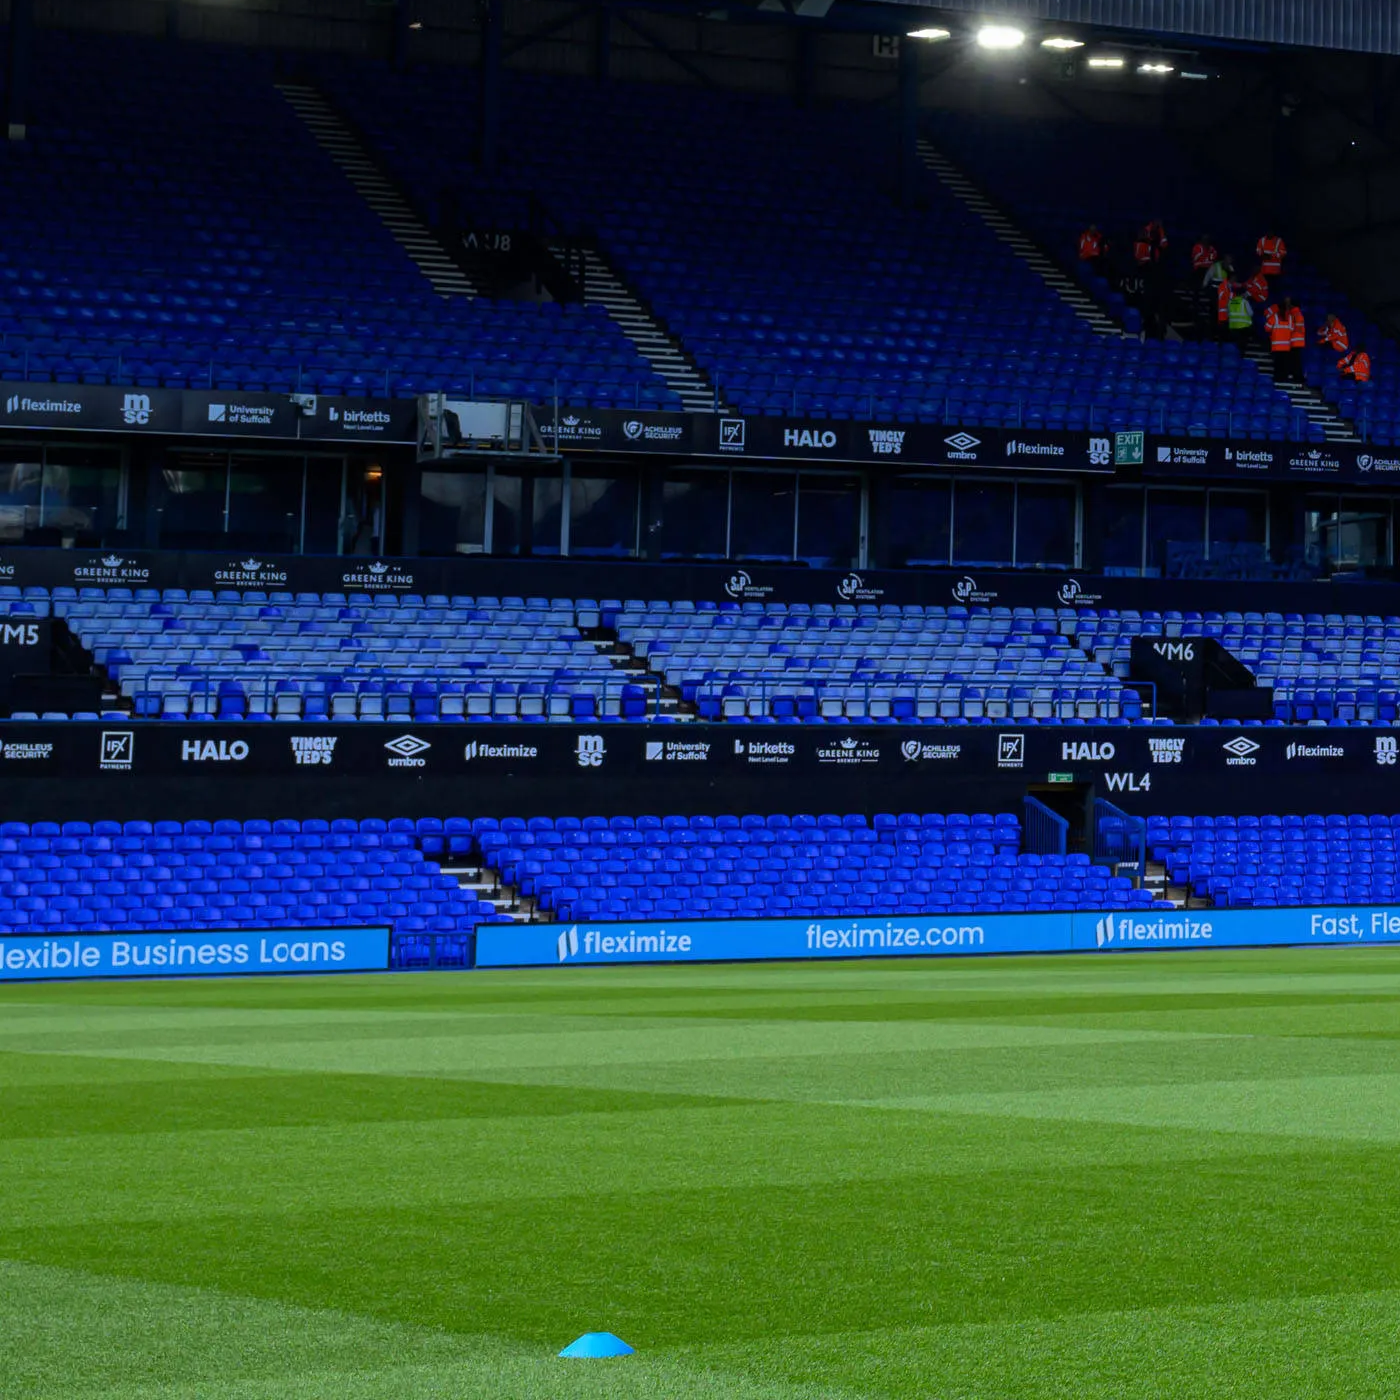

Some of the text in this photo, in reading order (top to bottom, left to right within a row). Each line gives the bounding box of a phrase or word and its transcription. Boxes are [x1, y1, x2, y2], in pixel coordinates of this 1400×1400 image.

[22, 398, 81, 414] fleximize
[230, 405, 275, 417] University
[229, 413, 272, 424] of Suffolk
[344, 410, 390, 423] birketts
[540, 425, 601, 436] GRENE KING
[644, 425, 682, 434] ACHILLEUS
[868, 429, 905, 442] TINGLY
[784, 429, 836, 448] HALO
[1117, 434, 1141, 445] EXIT
[947, 451, 977, 461] umbro
[1018, 443, 1064, 457] fleximize
[1174, 447, 1208, 458] University
[1237, 450, 1273, 462] birketts
[1174, 455, 1206, 464] of Suffolk
[1290, 459, 1339, 469] GREENE KING
[75, 567, 149, 579] GREENE KING
[214, 570, 287, 582] GREENE KING
[343, 573, 413, 585] GREENE KING
[0, 624, 40, 645] M5
[5, 743, 53, 752] ACHILLEUS
[182, 740, 249, 760] HALO
[291, 737, 337, 751] TINGLY
[666, 741, 710, 753] University
[749, 742, 794, 755] birketts
[1148, 738, 1184, 751] TINGLY
[480, 745, 537, 759] fleximize
[666, 751, 707, 761] of Suffolk
[818, 749, 879, 759] GREENE KING
[1062, 742, 1115, 761] HALO
[1297, 744, 1344, 758] fleximize
[388, 758, 425, 767] umbro
[1226, 757, 1256, 767] umbro
[1105, 773, 1151, 791] WL4
[1119, 919, 1212, 942] fleximize
[1310, 916, 1364, 940] Fast,
[585, 932, 692, 954] fleximize
[807, 923, 984, 951] fleximize.com
[112, 938, 249, 967] Business
[259, 937, 346, 961] Loans
